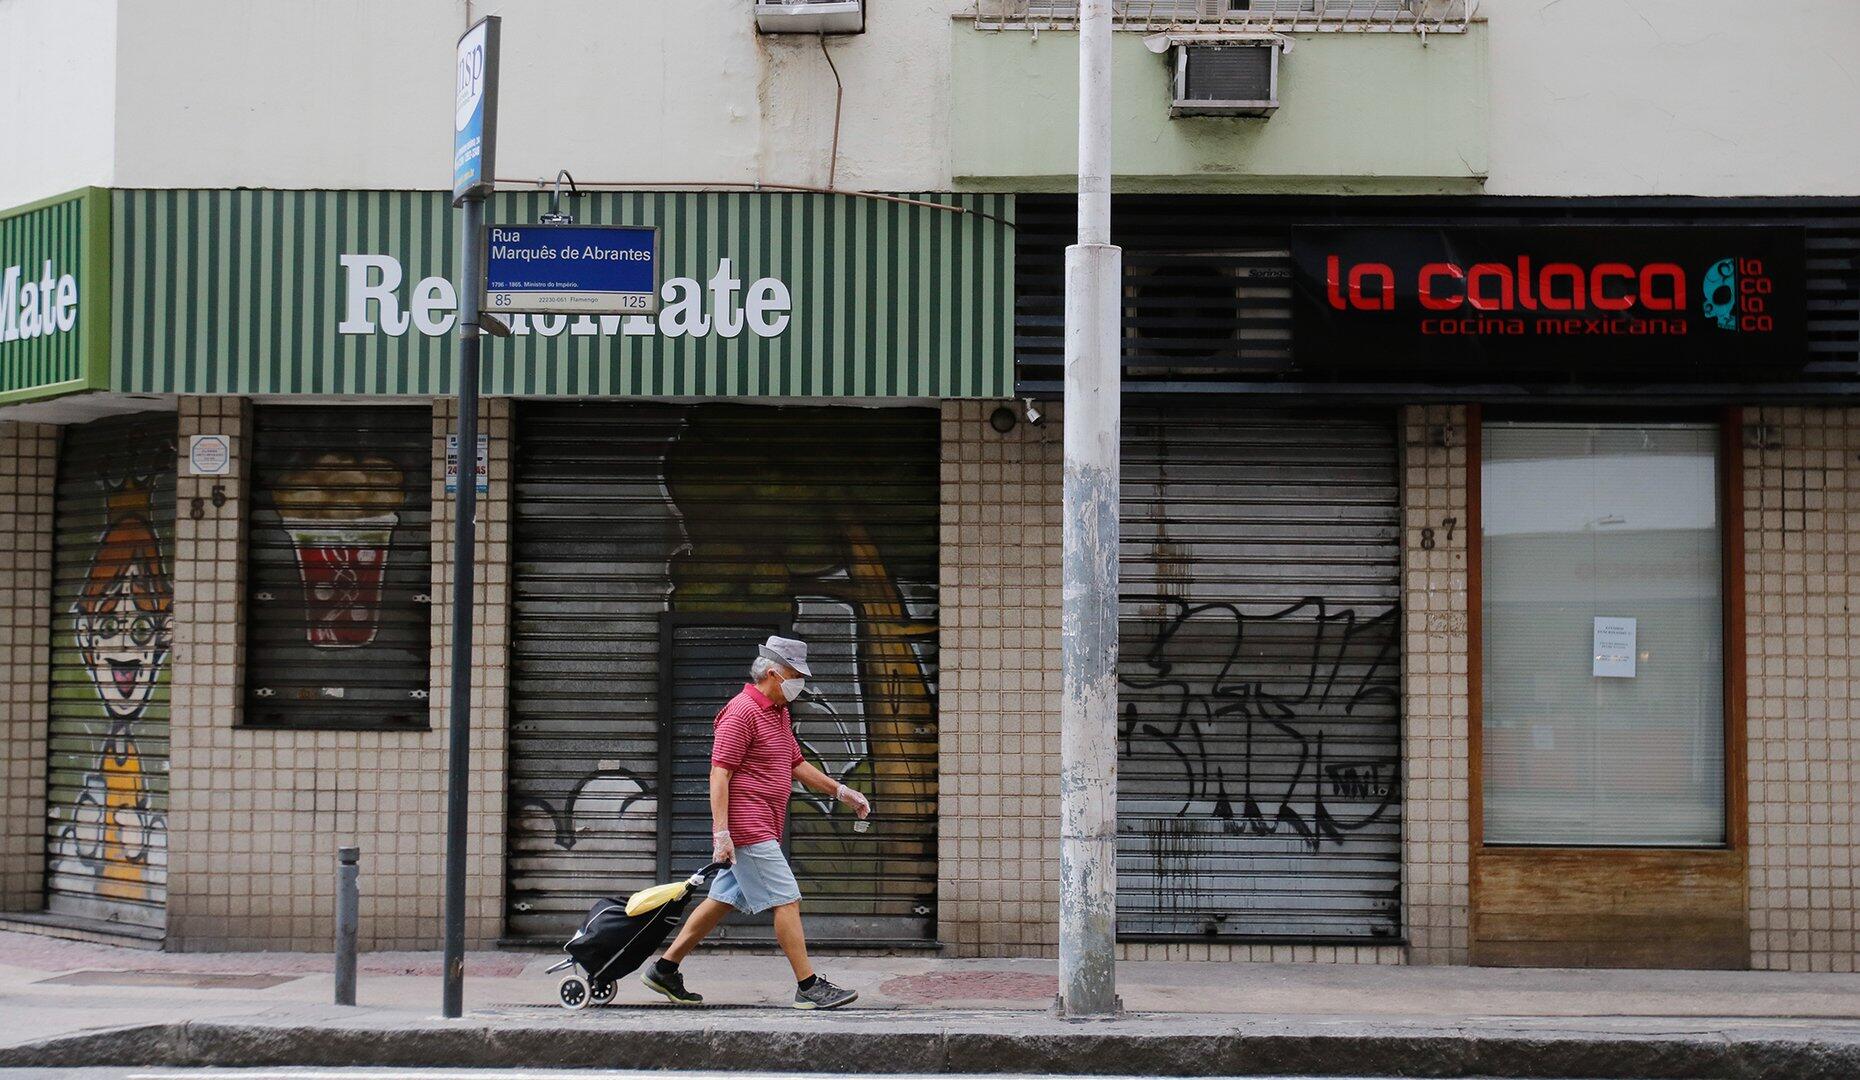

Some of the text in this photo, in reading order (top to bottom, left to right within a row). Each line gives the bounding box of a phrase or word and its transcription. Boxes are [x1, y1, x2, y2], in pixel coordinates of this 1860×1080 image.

[492, 229, 520, 243] Rua
[492, 245, 651, 262] Marquês de Abrantes
[1740, 257, 1762, 275] la
[1327, 255, 1686, 310] la calaca
[1741, 278, 1771, 293] ca
[495, 294, 512, 306] 85
[622, 296, 646, 308] 125
[1742, 295, 1763, 312] la
[1421, 315, 1687, 335] cocina mexicana
[1742, 316, 1773, 331] ca
[190, 485, 226, 521] 85
[1420, 517, 1457, 550] 87
